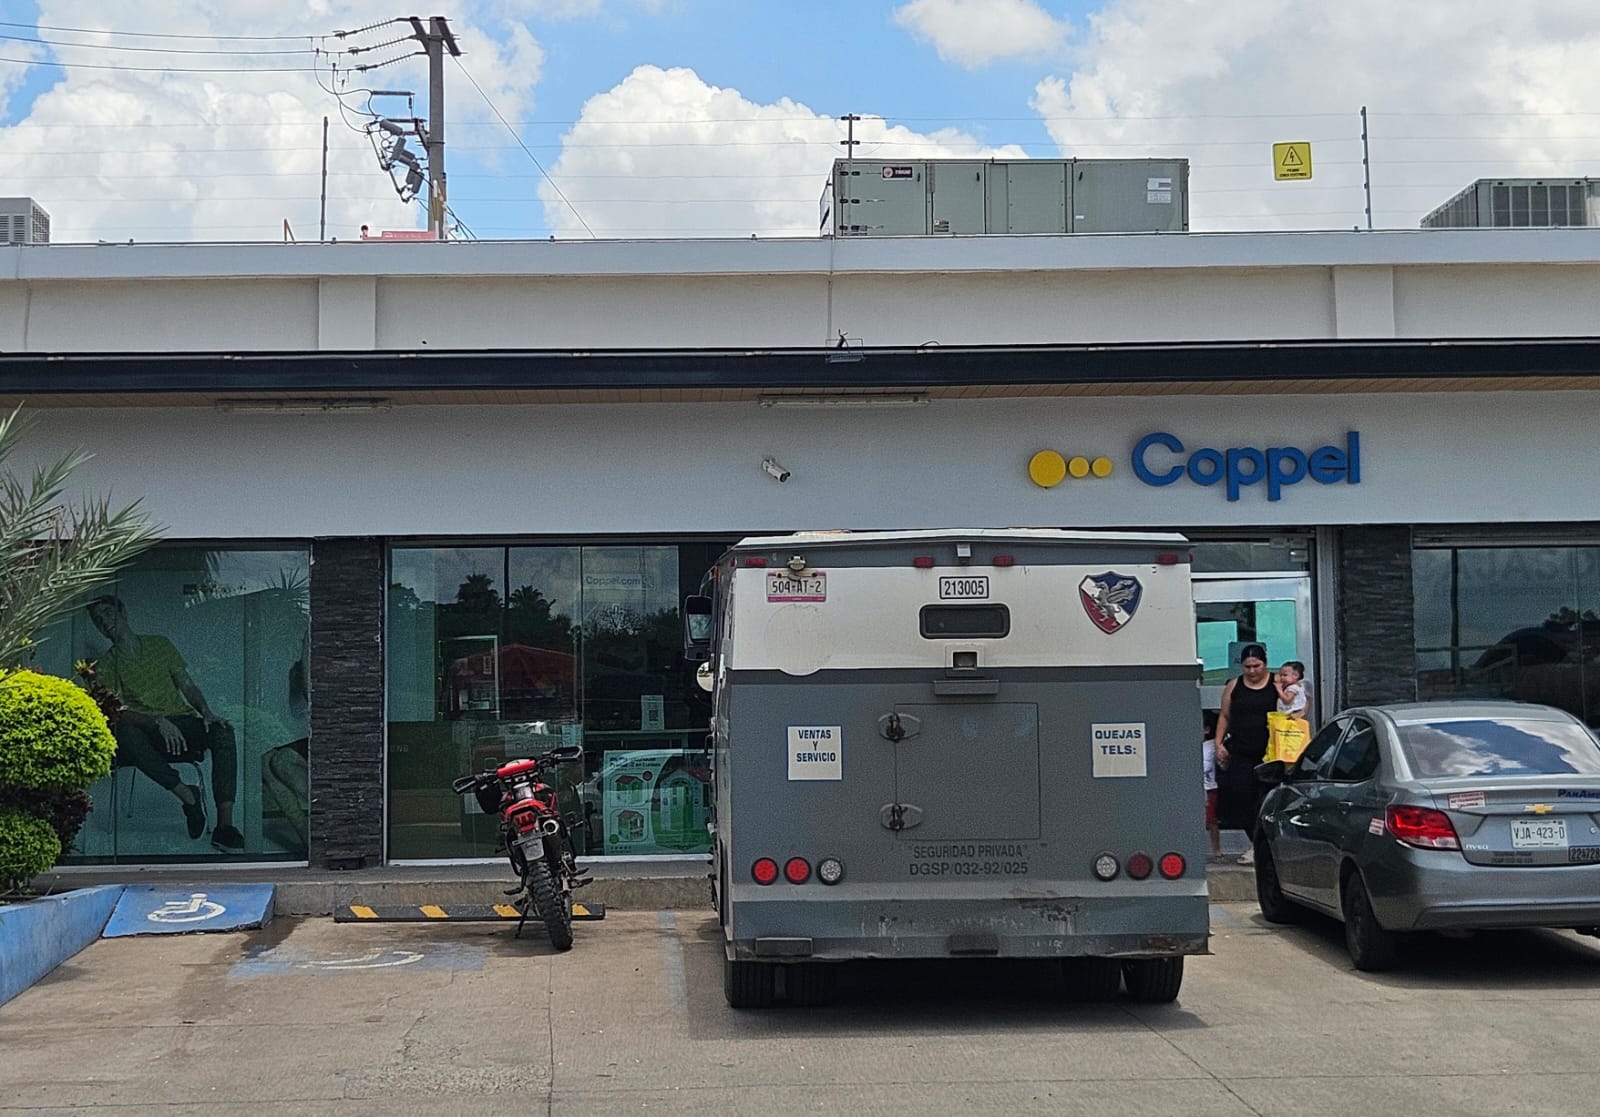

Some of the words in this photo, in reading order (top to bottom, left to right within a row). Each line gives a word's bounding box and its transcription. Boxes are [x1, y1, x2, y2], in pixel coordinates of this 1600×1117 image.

[1131, 431, 1361, 502] Coppel
[772, 580, 822, 593] 504-AT-2
[944, 580, 985, 595] 213005
[798, 729, 832, 739] VENTAS
[1095, 729, 1141, 740] QUEJAS
[812, 740, 819, 751] Y
[1100, 745, 1137, 755] TELS:
[796, 752, 836, 762] SERVICIO
